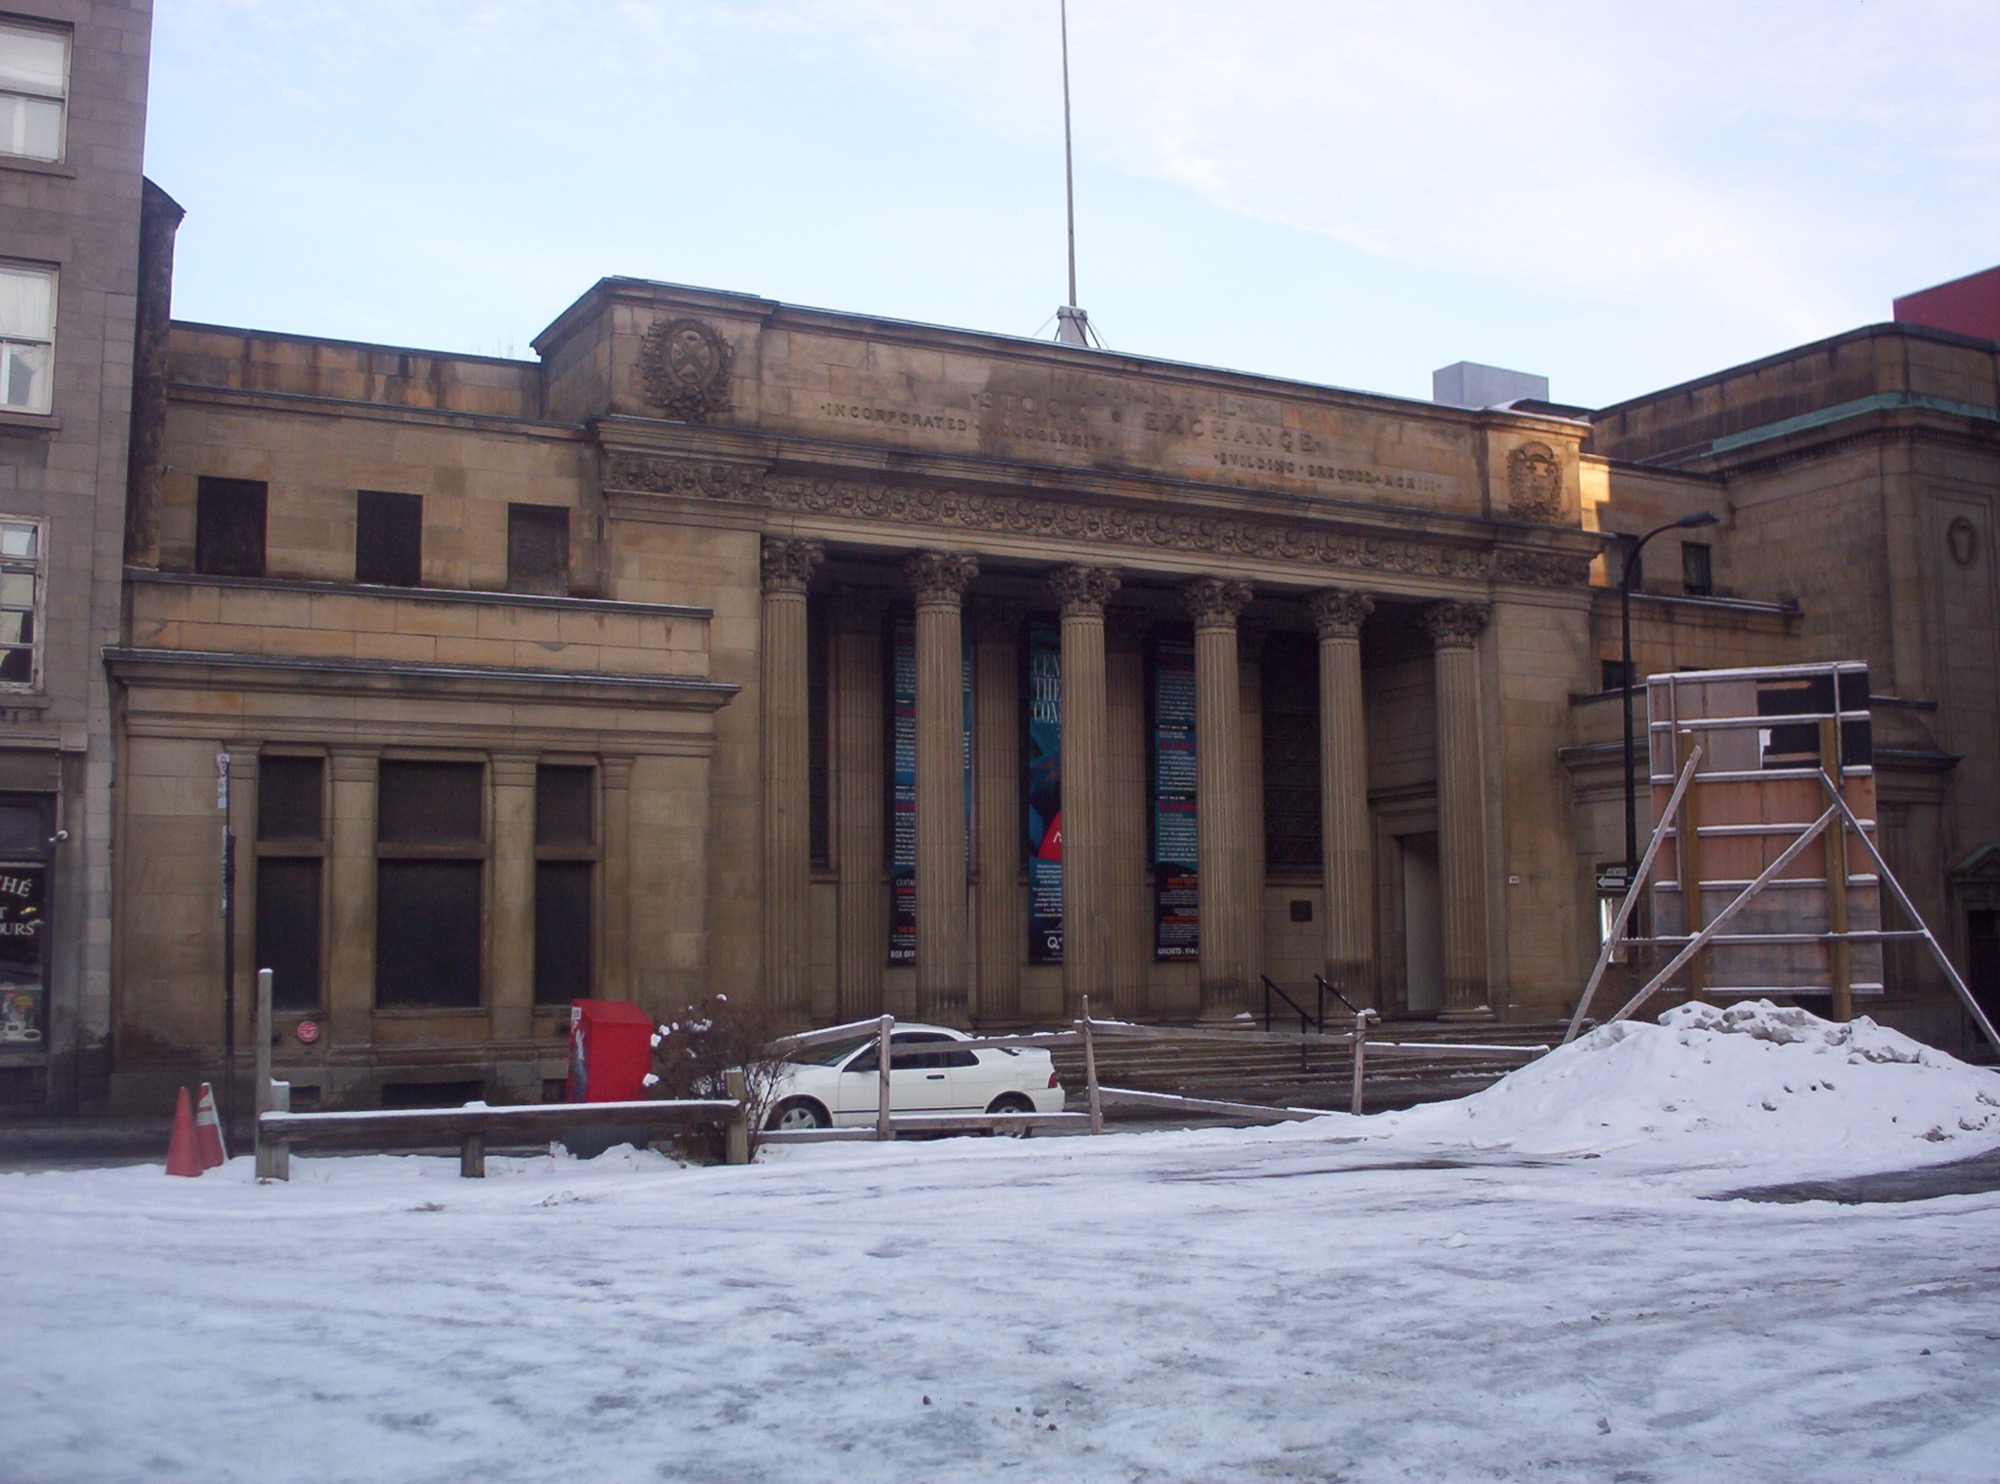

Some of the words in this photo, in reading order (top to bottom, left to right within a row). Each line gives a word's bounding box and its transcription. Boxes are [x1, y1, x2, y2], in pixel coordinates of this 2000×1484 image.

[825, 402, 967, 432] INCORPORATED
[1308, 463, 1373, 485] ERECTED
[980, 391, 1089, 421] STOCK
[1145, 412, 1314, 454] EXCHANGE
[0, 874, 33, 898] HÉ
